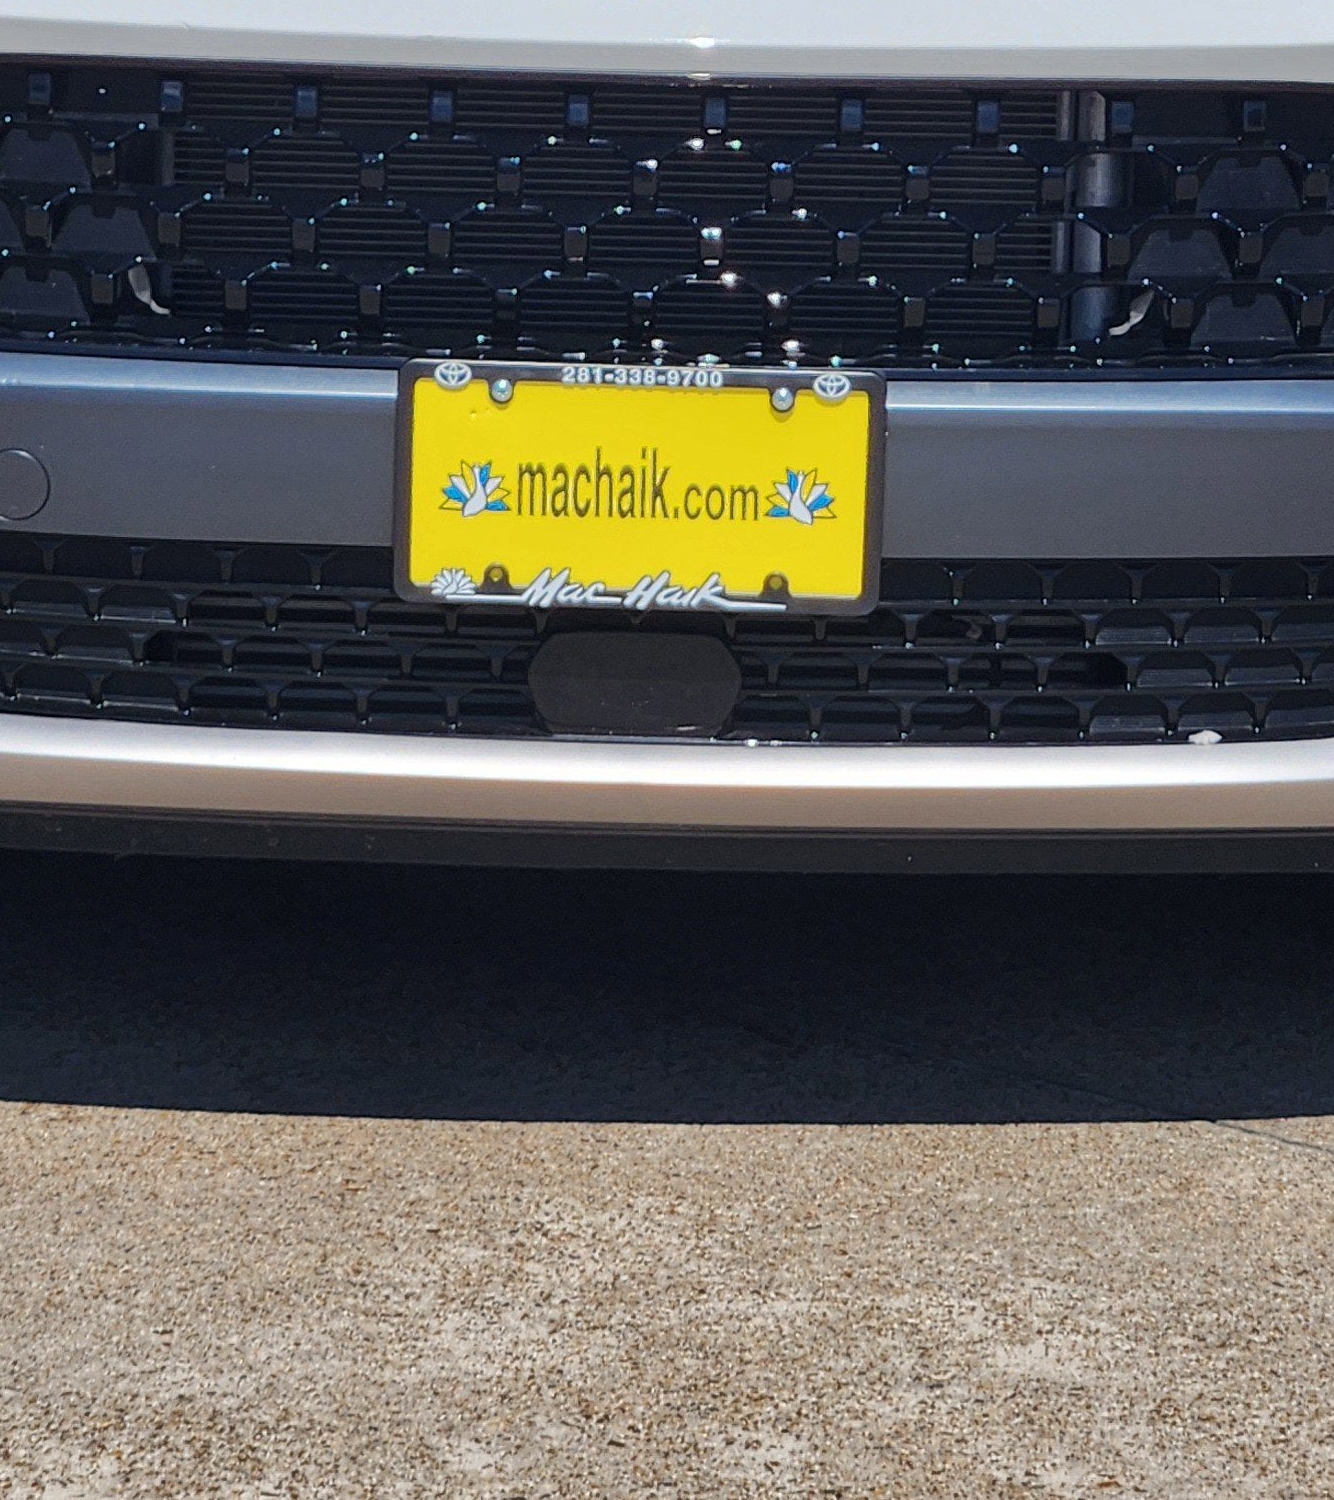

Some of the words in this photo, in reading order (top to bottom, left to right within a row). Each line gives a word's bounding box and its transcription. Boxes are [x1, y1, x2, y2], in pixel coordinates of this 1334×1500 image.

[560, 365, 724, 390] 281-338-9700
[516, 446, 760, 521] machaik.com
[521, 566, 609, 608] Mac
[621, 570, 727, 612] Haik
